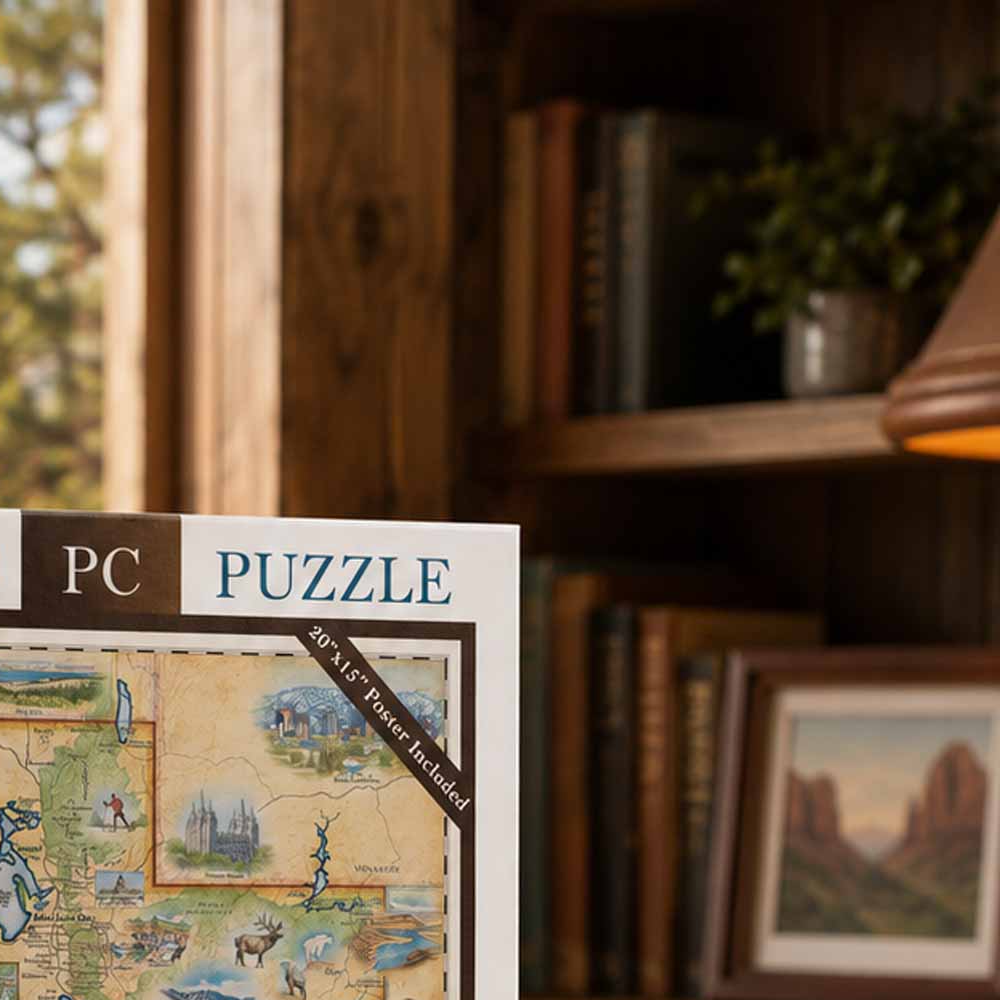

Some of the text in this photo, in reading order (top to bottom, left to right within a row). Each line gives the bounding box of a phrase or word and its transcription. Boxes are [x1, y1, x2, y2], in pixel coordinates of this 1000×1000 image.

[62, 545, 142, 597] PC
[216, 550, 453, 606] PUZZLE
[364, 687, 410, 741] Poster
[408, 740, 471, 811] Included
